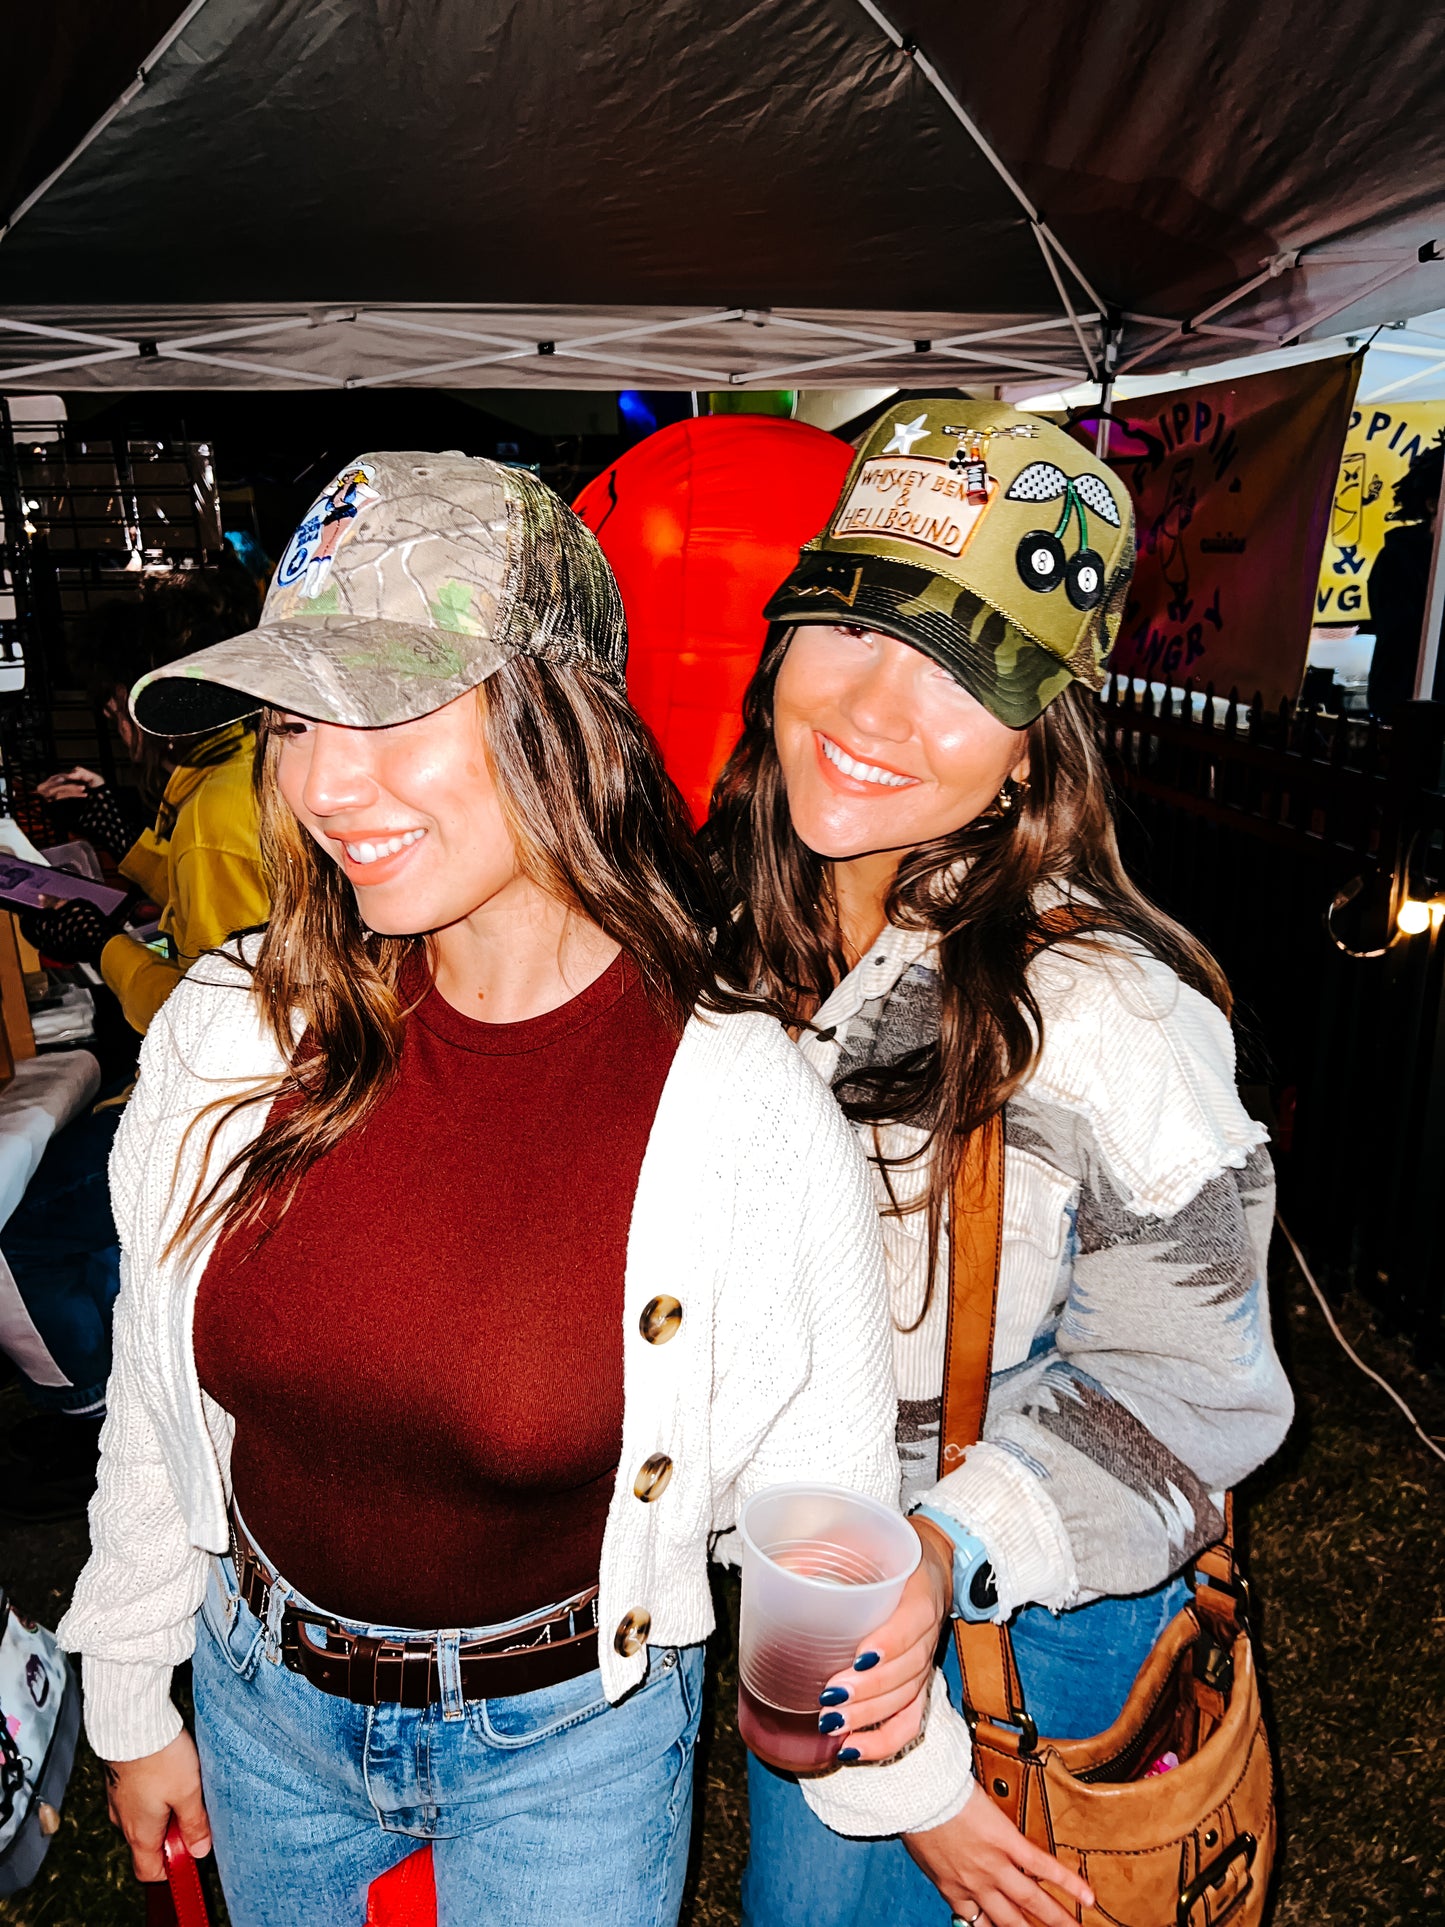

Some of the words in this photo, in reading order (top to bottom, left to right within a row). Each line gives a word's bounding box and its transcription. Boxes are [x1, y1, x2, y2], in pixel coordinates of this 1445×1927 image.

[861, 468, 930, 493] WHISKEY
[896, 488, 910, 508] &
[840, 508, 960, 546] HELLBOUND
[1038, 551, 1047, 571] 8
